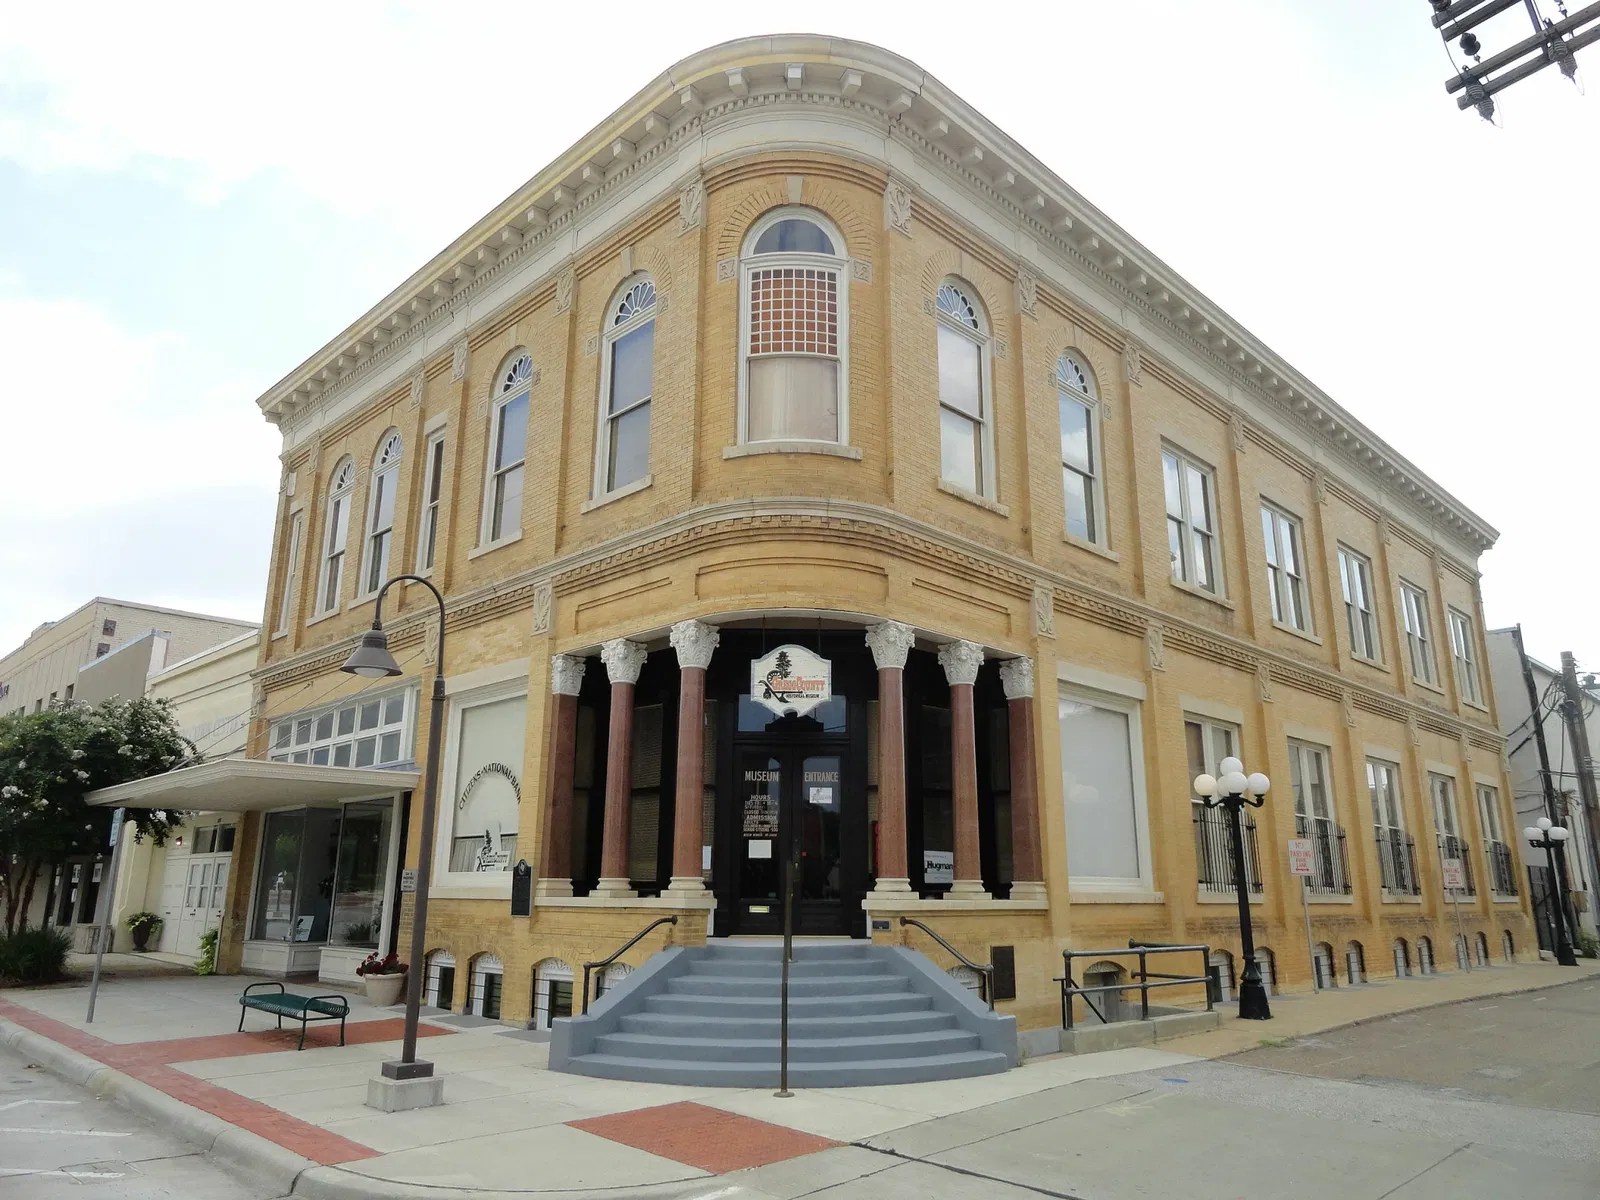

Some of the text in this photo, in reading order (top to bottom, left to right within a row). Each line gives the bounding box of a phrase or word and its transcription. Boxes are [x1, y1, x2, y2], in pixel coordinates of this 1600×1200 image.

[797, 676, 825, 691] COUNTY
[483, 763, 512, 780] NATIONAL
[744, 771, 838, 782] MUSEUM ENTRANCE
